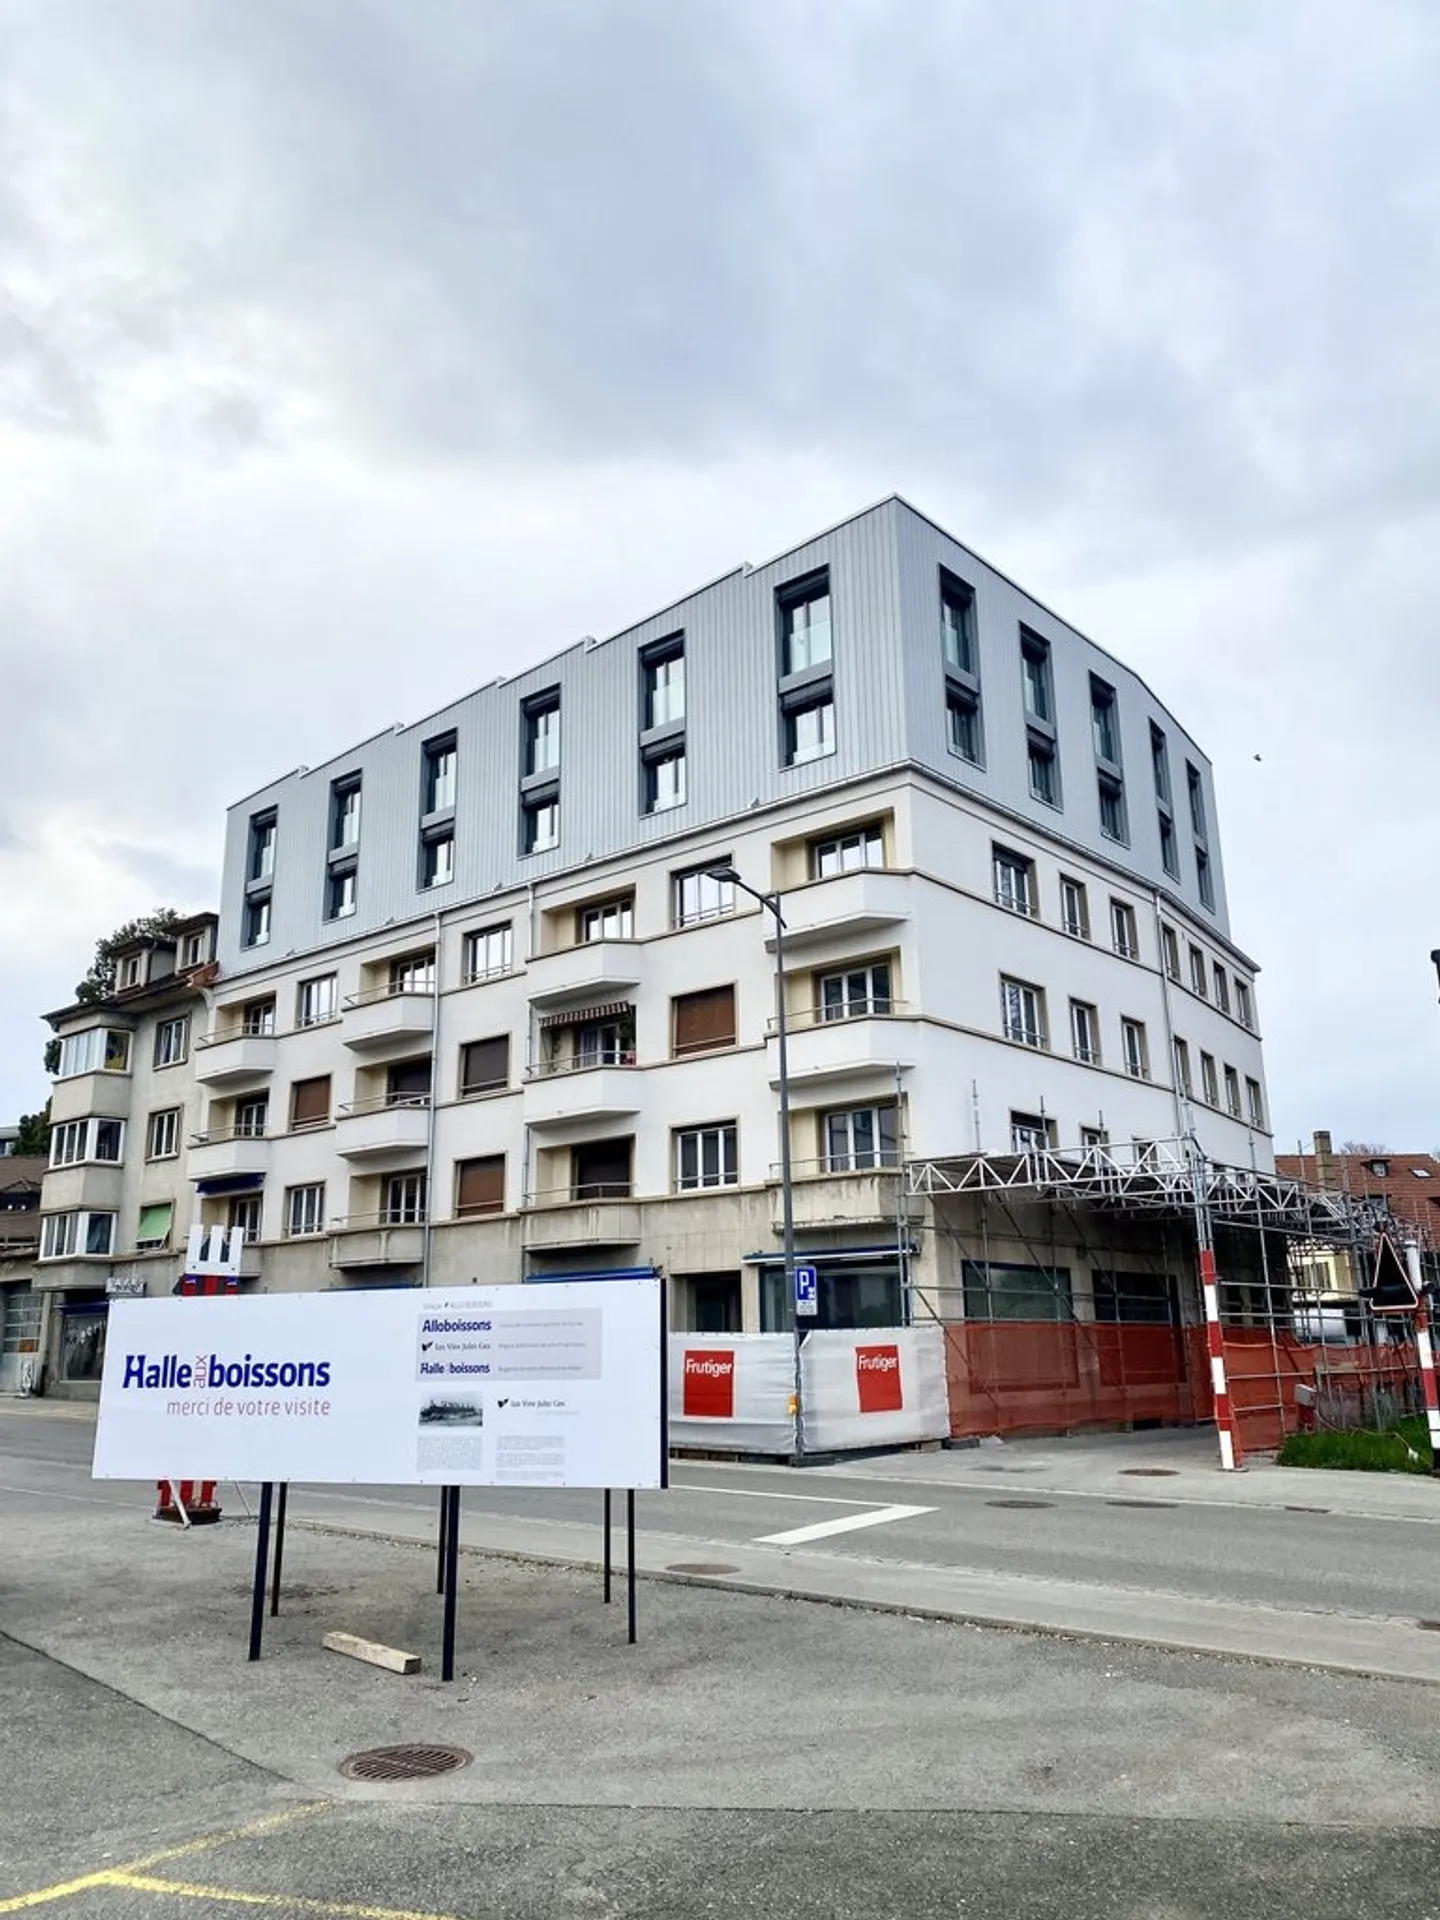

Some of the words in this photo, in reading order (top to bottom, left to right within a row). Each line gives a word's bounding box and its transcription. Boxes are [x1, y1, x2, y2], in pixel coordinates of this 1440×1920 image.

[798, 1271, 810, 1295] P
[422, 1318, 492, 1333] Alloboissons
[122, 1354, 193, 1389] Halle
[193, 1355, 208, 1389] aux
[208, 1353, 331, 1389] boissons
[420, 1361, 445, 1374] Halle
[450, 1361, 491, 1374] boissons
[685, 1359, 732, 1379] Frutiger
[858, 1354, 898, 1373] Frutiger
[166, 1397, 210, 1417] merci
[213, 1397, 233, 1416] de
[238, 1400, 281, 1417] votre
[285, 1397, 331, 1416] visite
